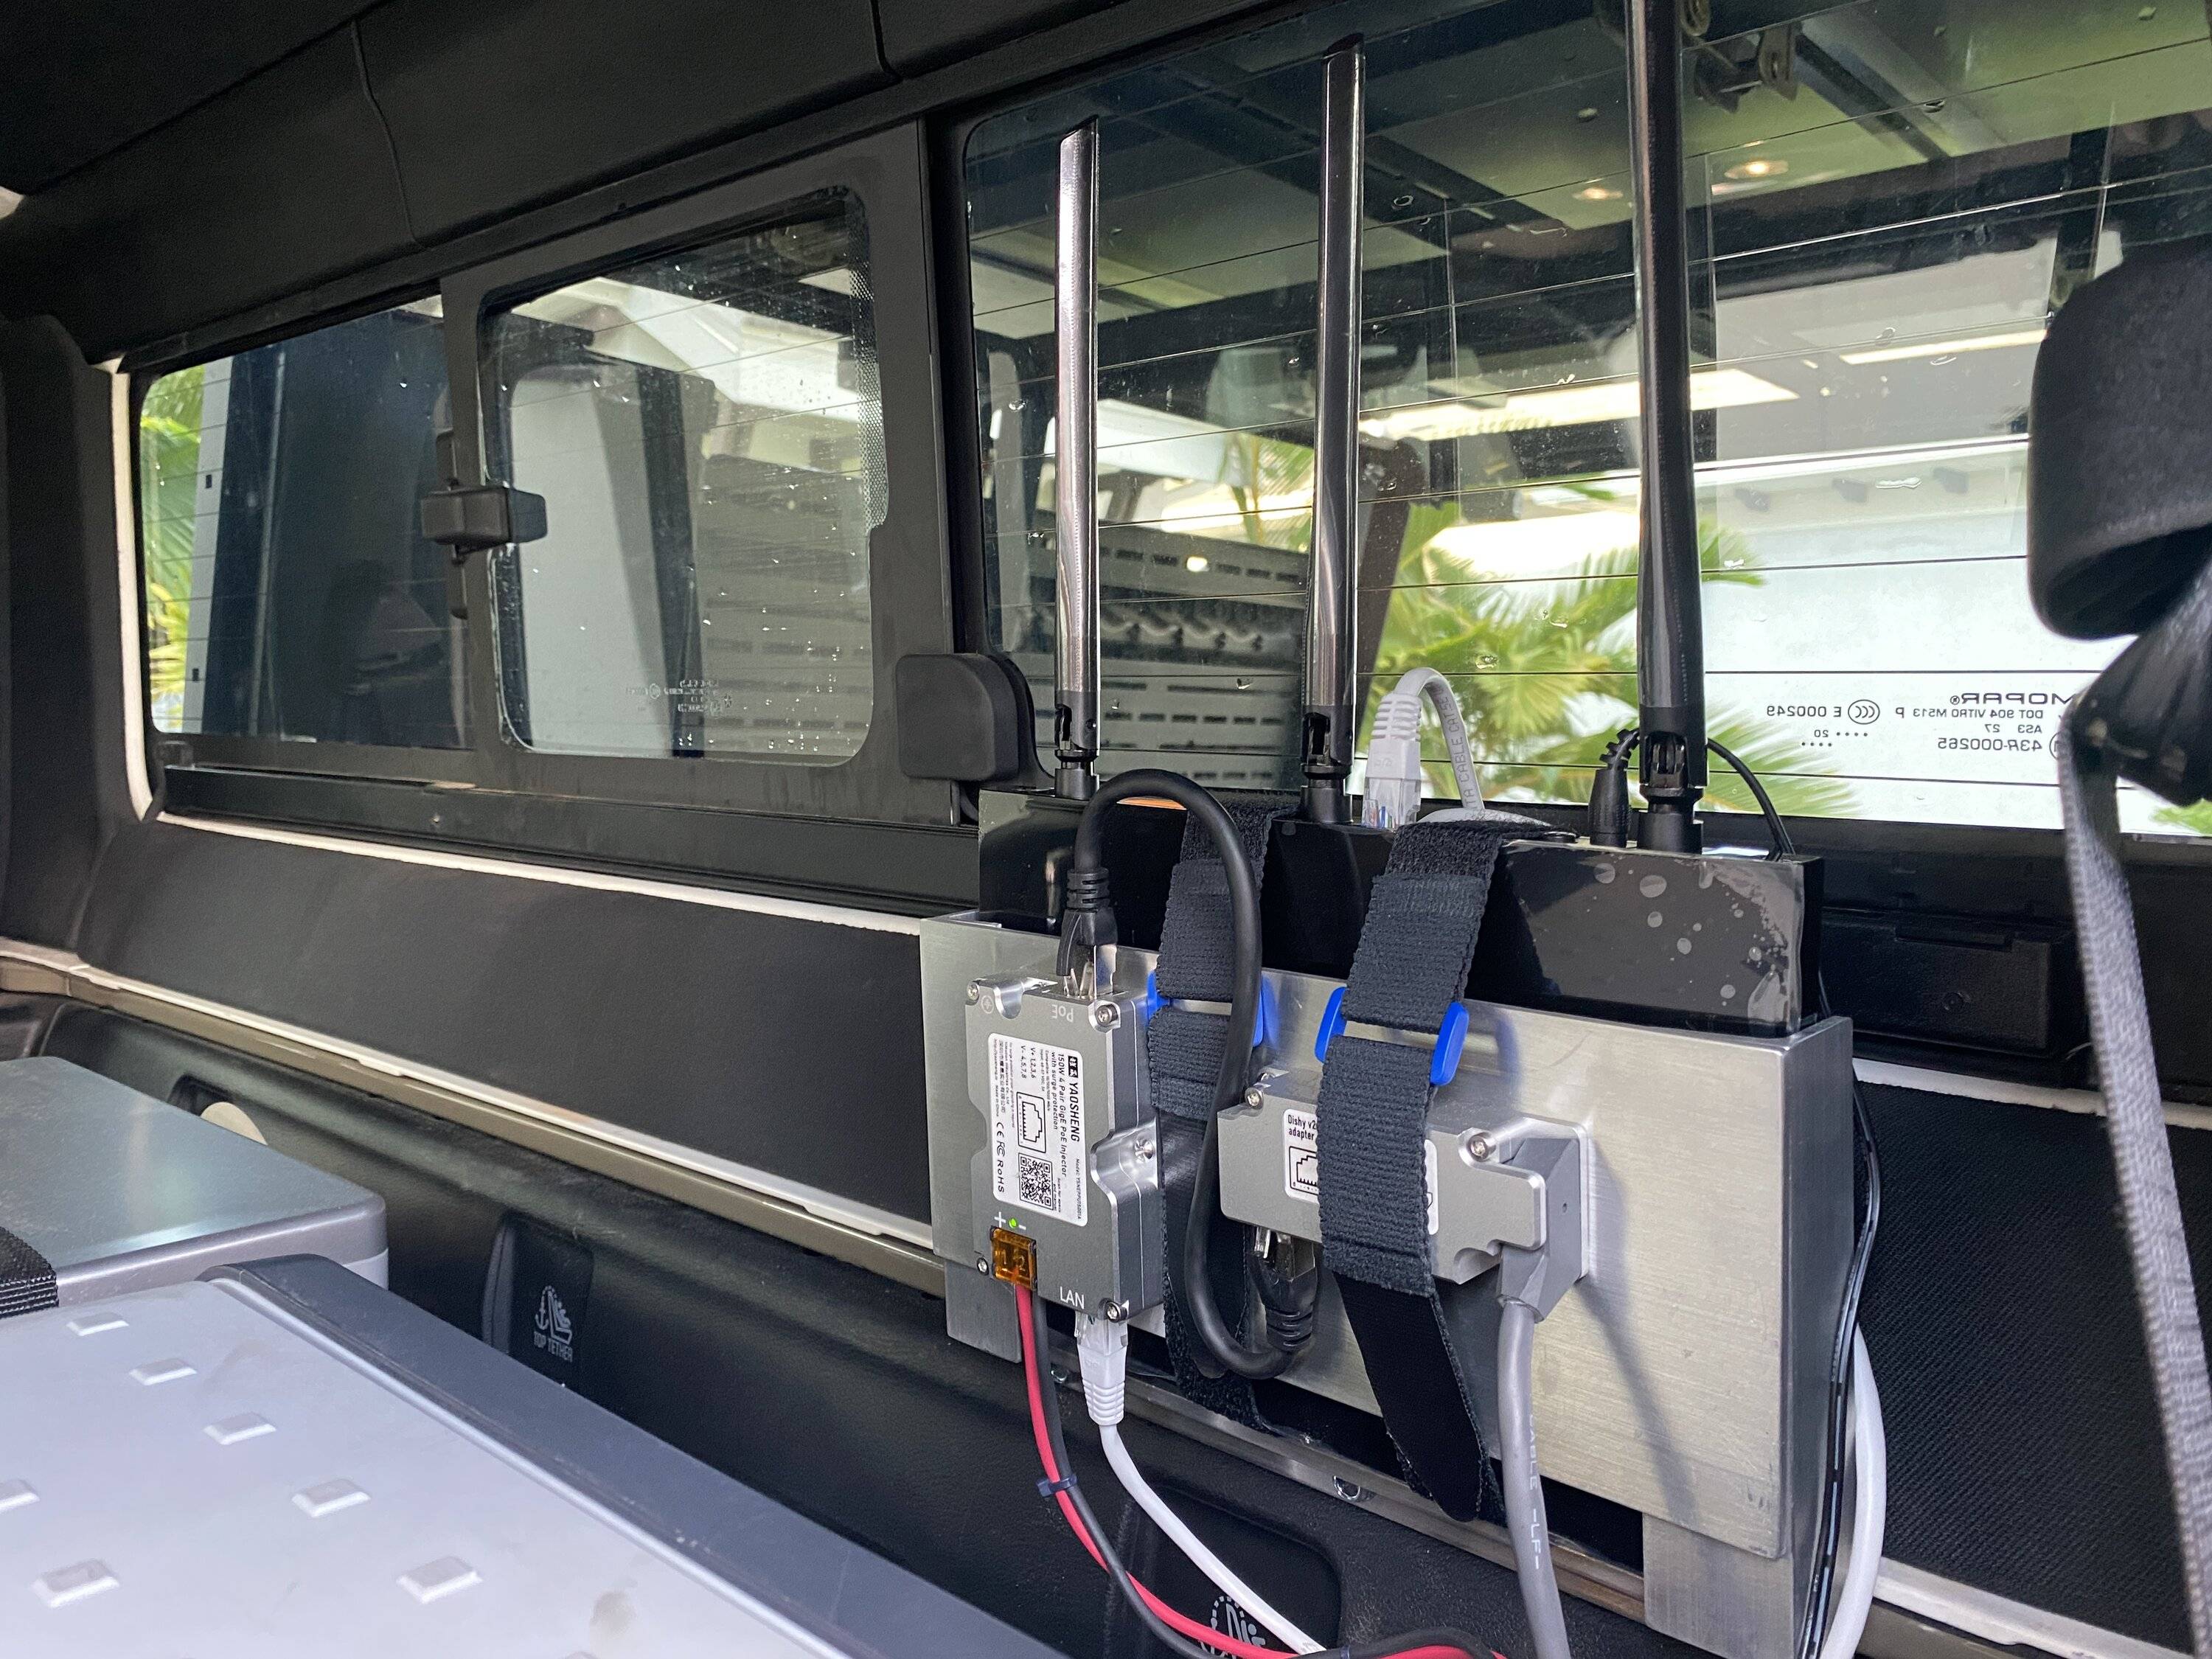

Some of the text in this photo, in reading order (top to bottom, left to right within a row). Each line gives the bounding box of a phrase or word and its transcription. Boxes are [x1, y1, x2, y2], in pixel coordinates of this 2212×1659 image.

[1451, 737, 1470, 783] CABLE
[1051, 1004, 1074, 1023] PoE
[1030, 1048, 1036, 1056] V+
[1058, 1105, 1066, 1124] GigE
[1069, 1082, 1079, 1142] YAOSHENG
[1287, 1114, 1307, 1129] Dishy
[1289, 1127, 1315, 1141] adapter
[1059, 1144, 1067, 1178] Injector
[1060, 1286, 1085, 1310] LAN
